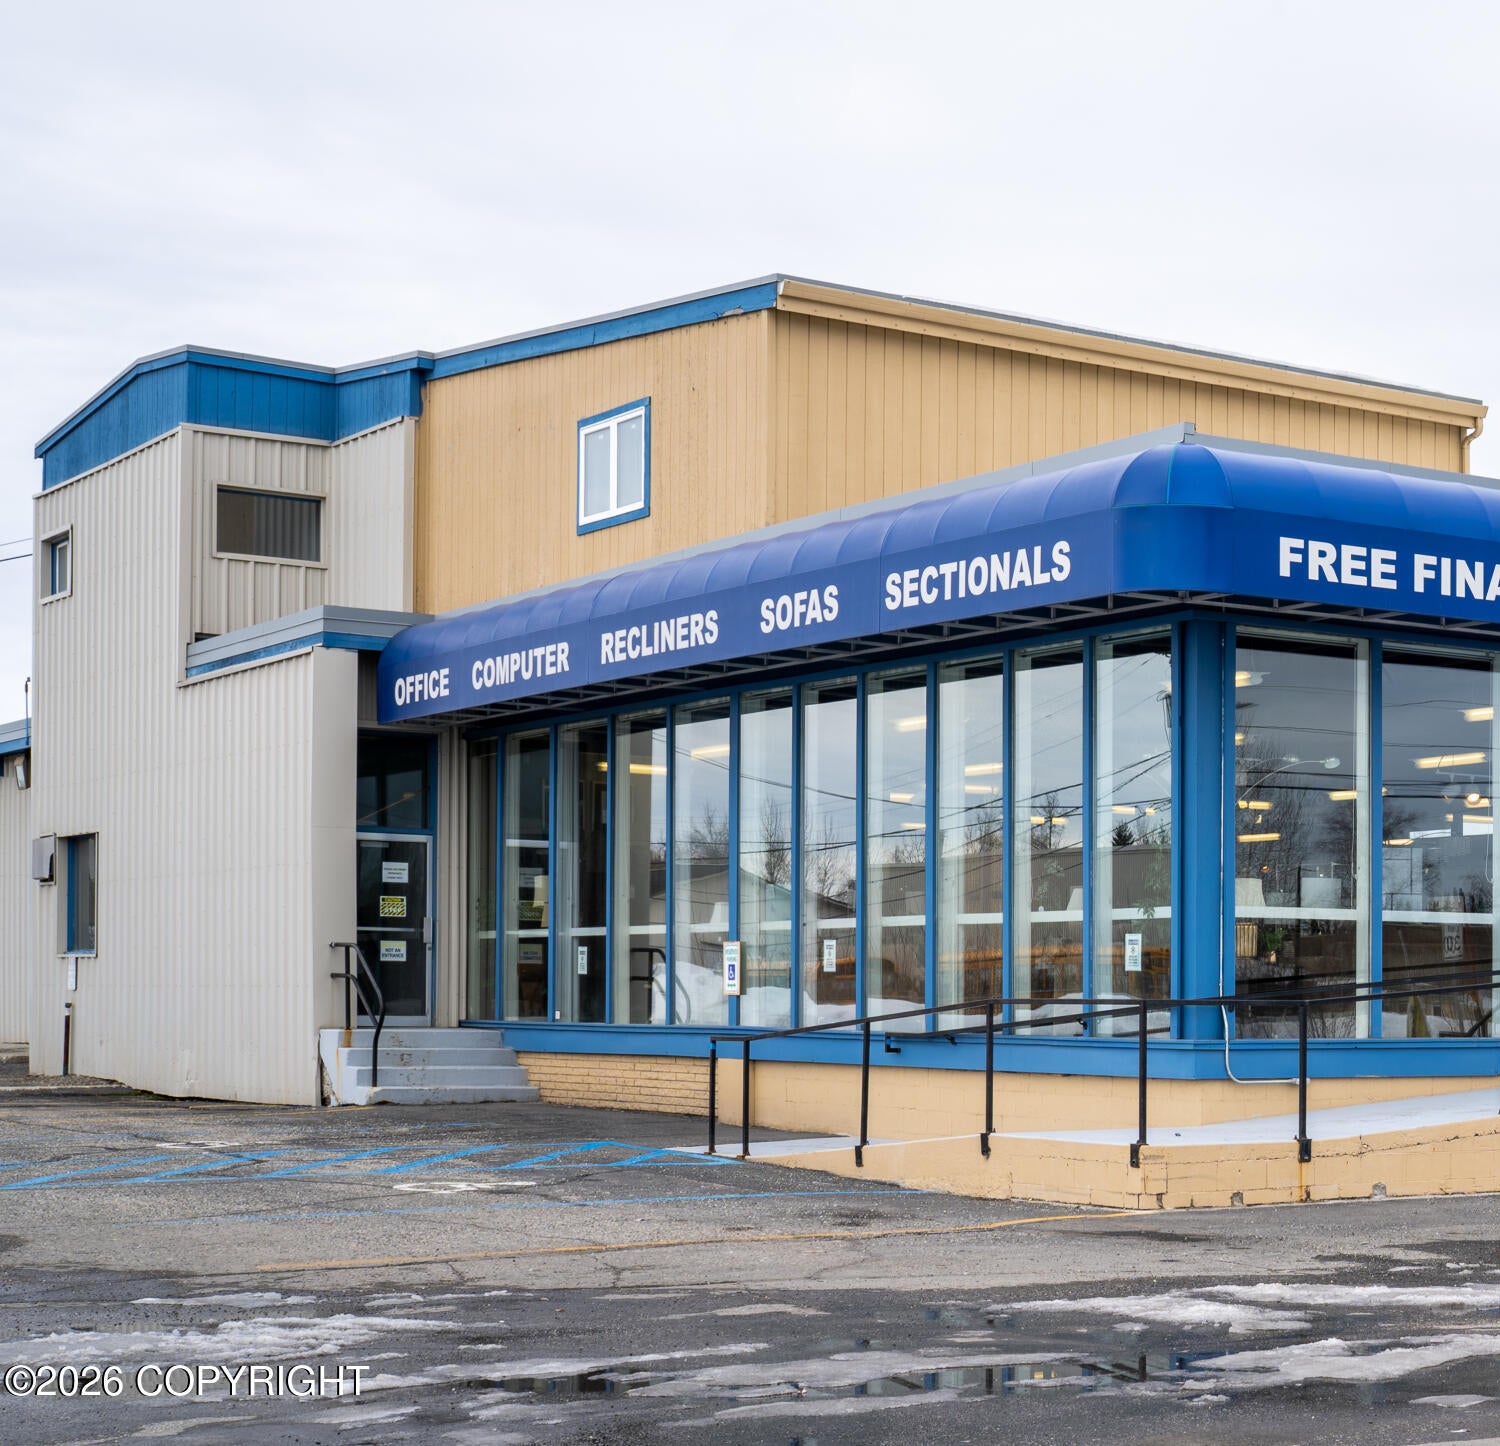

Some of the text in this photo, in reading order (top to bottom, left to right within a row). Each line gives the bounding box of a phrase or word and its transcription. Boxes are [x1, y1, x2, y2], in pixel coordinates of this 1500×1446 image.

[884, 540, 1071, 610] SECTIONALS
[1278, 536, 1398, 590] FREE
[760, 584, 839, 633] SOFAS
[601, 609, 719, 665] RECLINERS
[394, 667, 450, 706] OFFICE
[471, 641, 570, 690] COMPUTER
